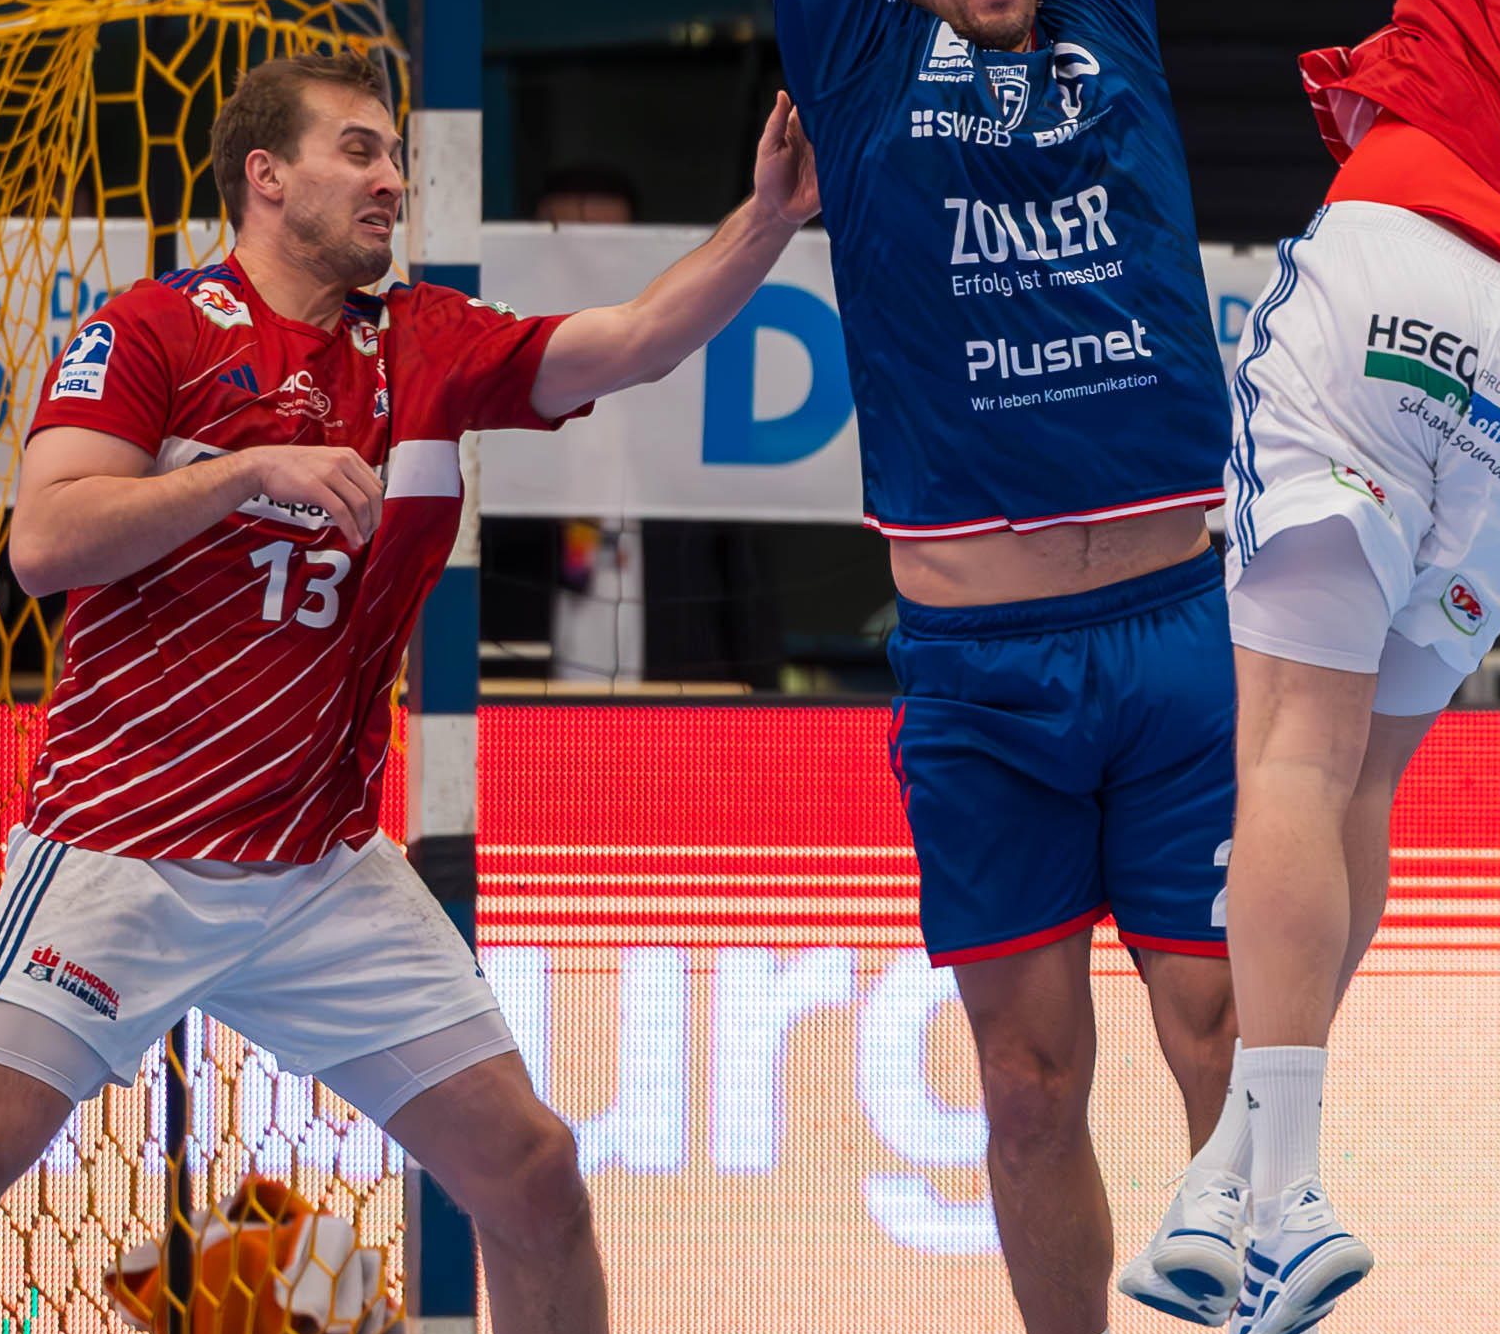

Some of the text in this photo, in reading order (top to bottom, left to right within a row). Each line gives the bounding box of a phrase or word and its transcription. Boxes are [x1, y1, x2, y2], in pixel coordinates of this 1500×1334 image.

[928, 57, 974, 69] EDEKA
[944, 185, 1117, 265] ZOLLER
[952, 259, 1124, 297] Erfolg ist messbar
[965, 318, 1153, 382] Plusnet
[56, 378, 97, 394] HBL
[971, 373, 1158, 411] Wir leben Kommunikation
[249, 540, 350, 628] 13
[56, 975, 118, 1021] HAMBURG
[63, 960, 121, 1007] HANDBALL
